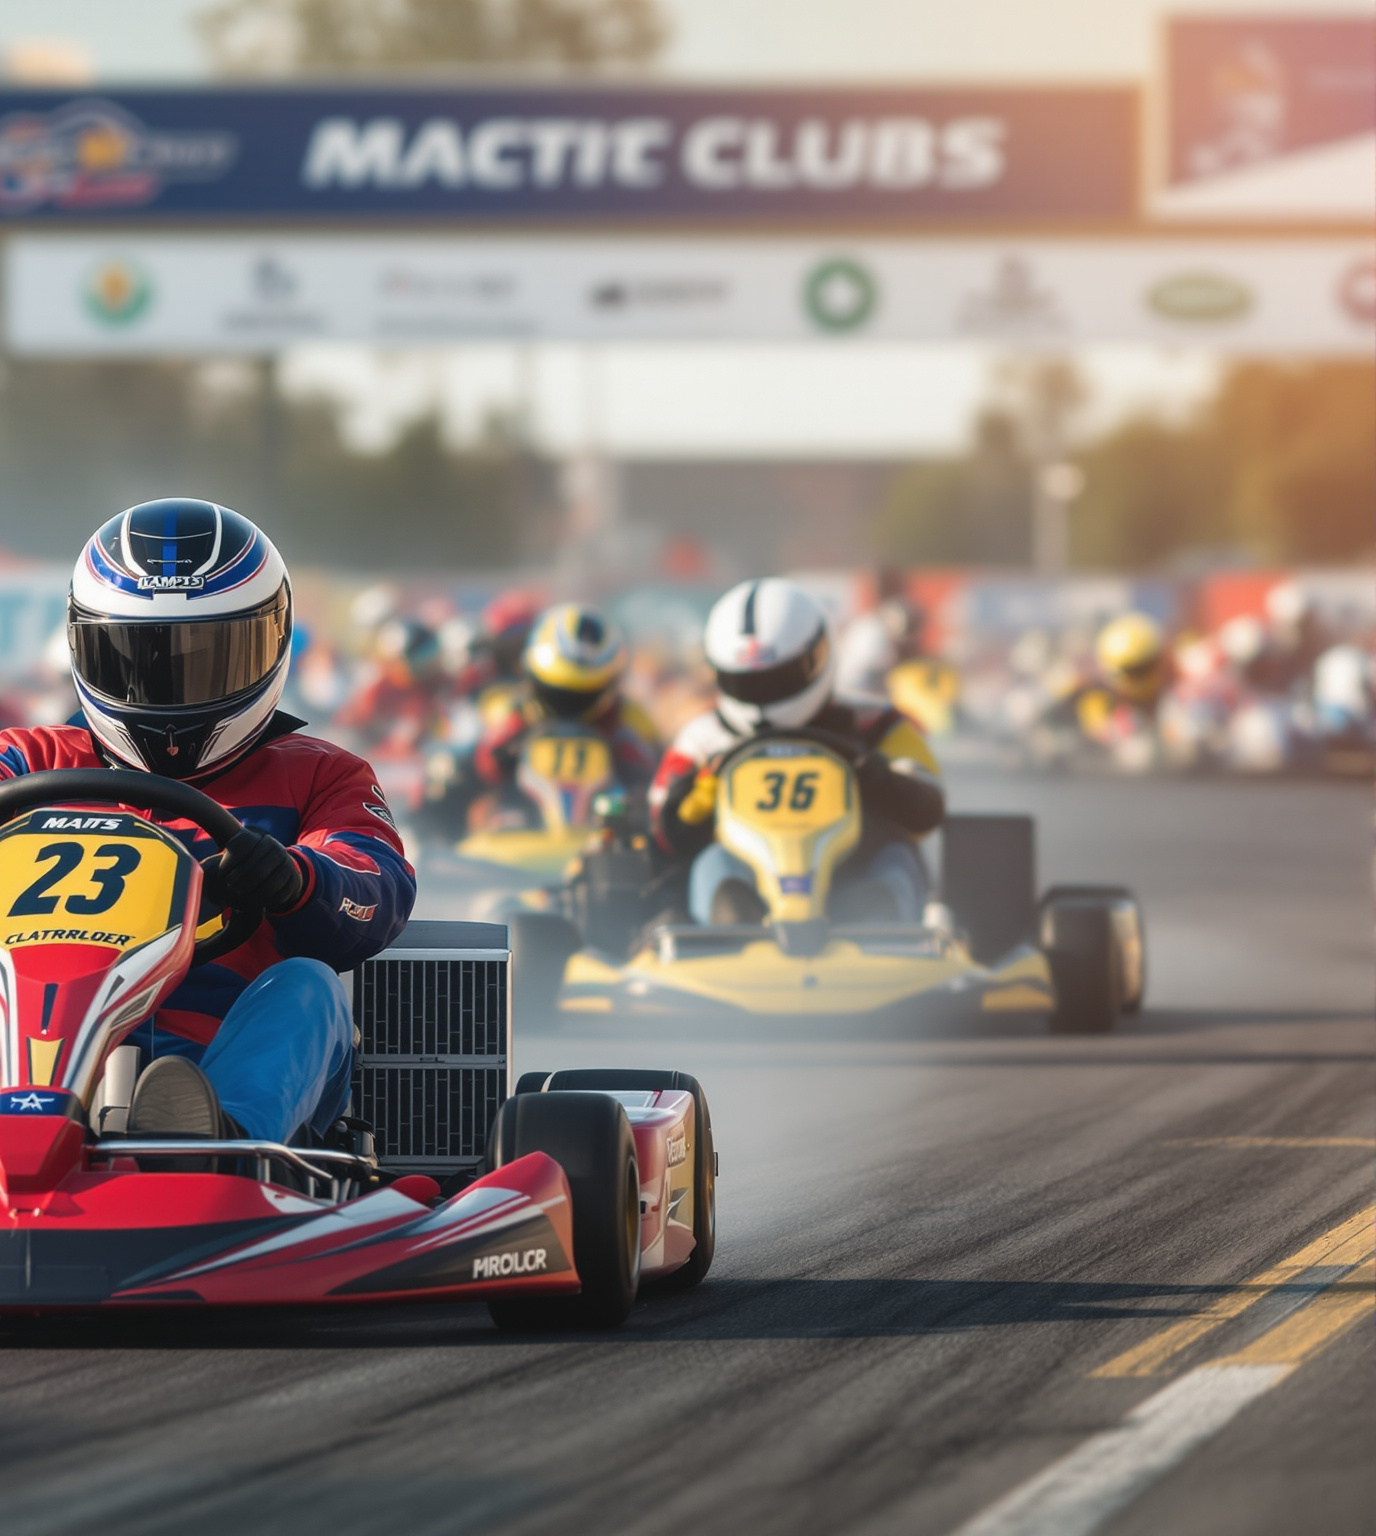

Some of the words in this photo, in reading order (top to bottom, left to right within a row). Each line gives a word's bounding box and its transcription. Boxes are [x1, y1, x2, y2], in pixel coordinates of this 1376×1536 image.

[683, 117, 1007, 188] CLUBS
[756, 771, 821, 812] 36
[7, 841, 141, 917] 23
